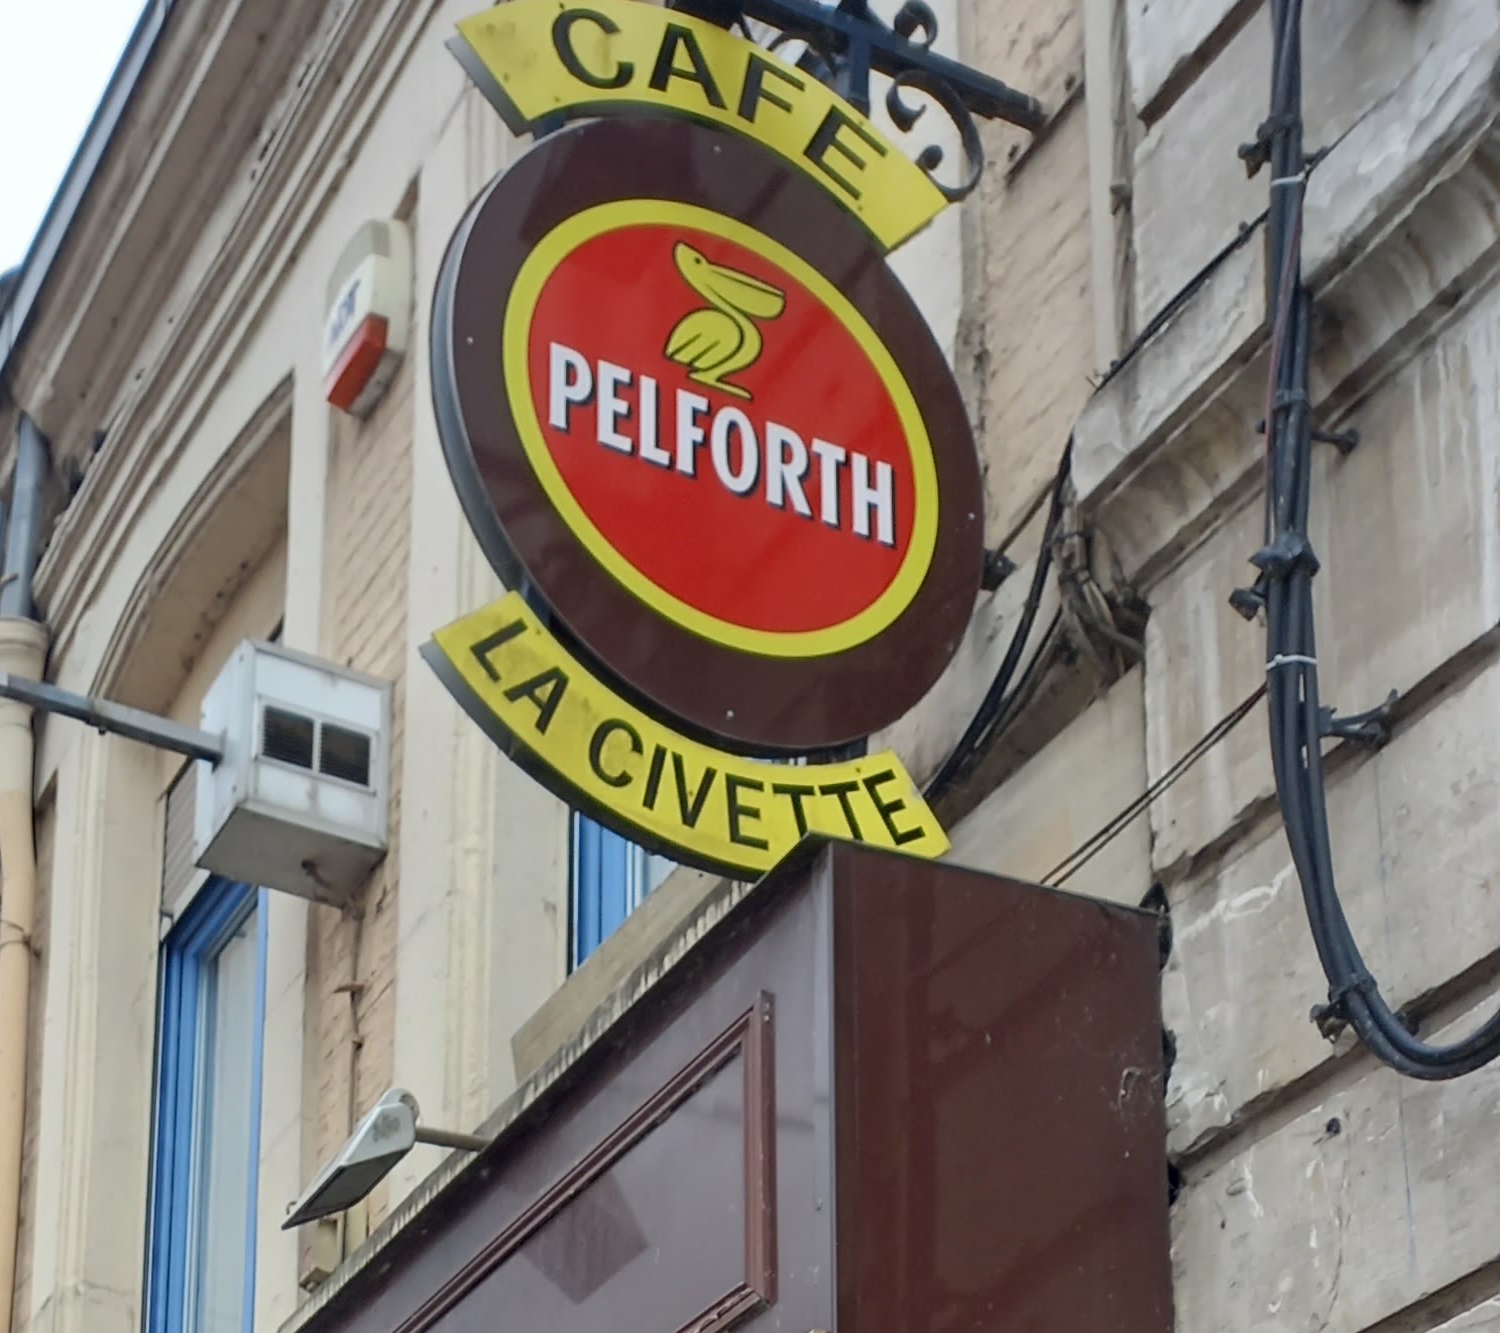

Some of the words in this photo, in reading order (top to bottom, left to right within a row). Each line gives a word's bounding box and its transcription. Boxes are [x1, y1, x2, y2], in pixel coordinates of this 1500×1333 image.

[551, 7, 890, 201] CAFE
[549, 342, 897, 546] PELFORTH
[469, 617, 571, 734] LA
[588, 717, 928, 851] CIVETTE
